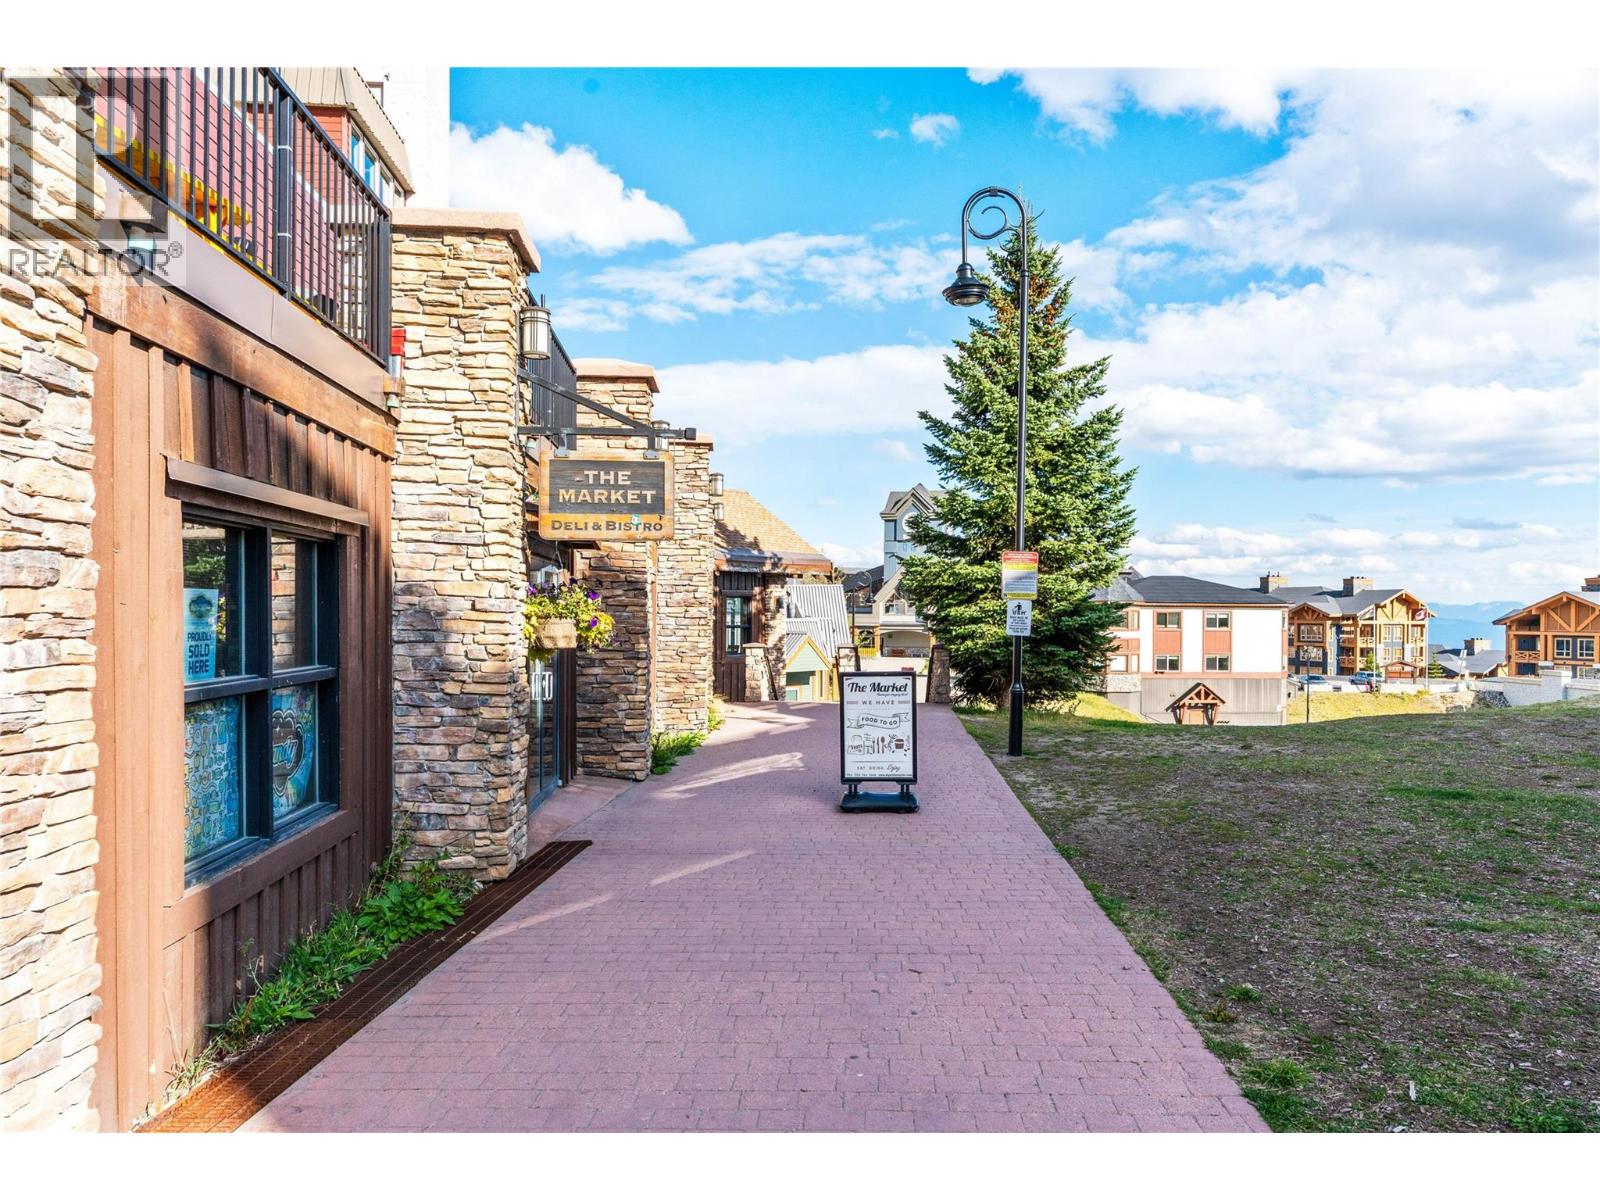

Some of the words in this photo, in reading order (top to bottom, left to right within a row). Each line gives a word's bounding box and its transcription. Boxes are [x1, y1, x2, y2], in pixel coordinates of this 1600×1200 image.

[583, 470, 632, 485] THE
[558, 488, 657, 504] MARKET
[591, 522, 602, 531] &
[187, 631, 212, 642] PROUDLY
[188, 644, 210, 658] SOLD
[188, 660, 209, 675] HERE
[847, 682, 867, 693] The
[869, 682, 908, 693] Market
